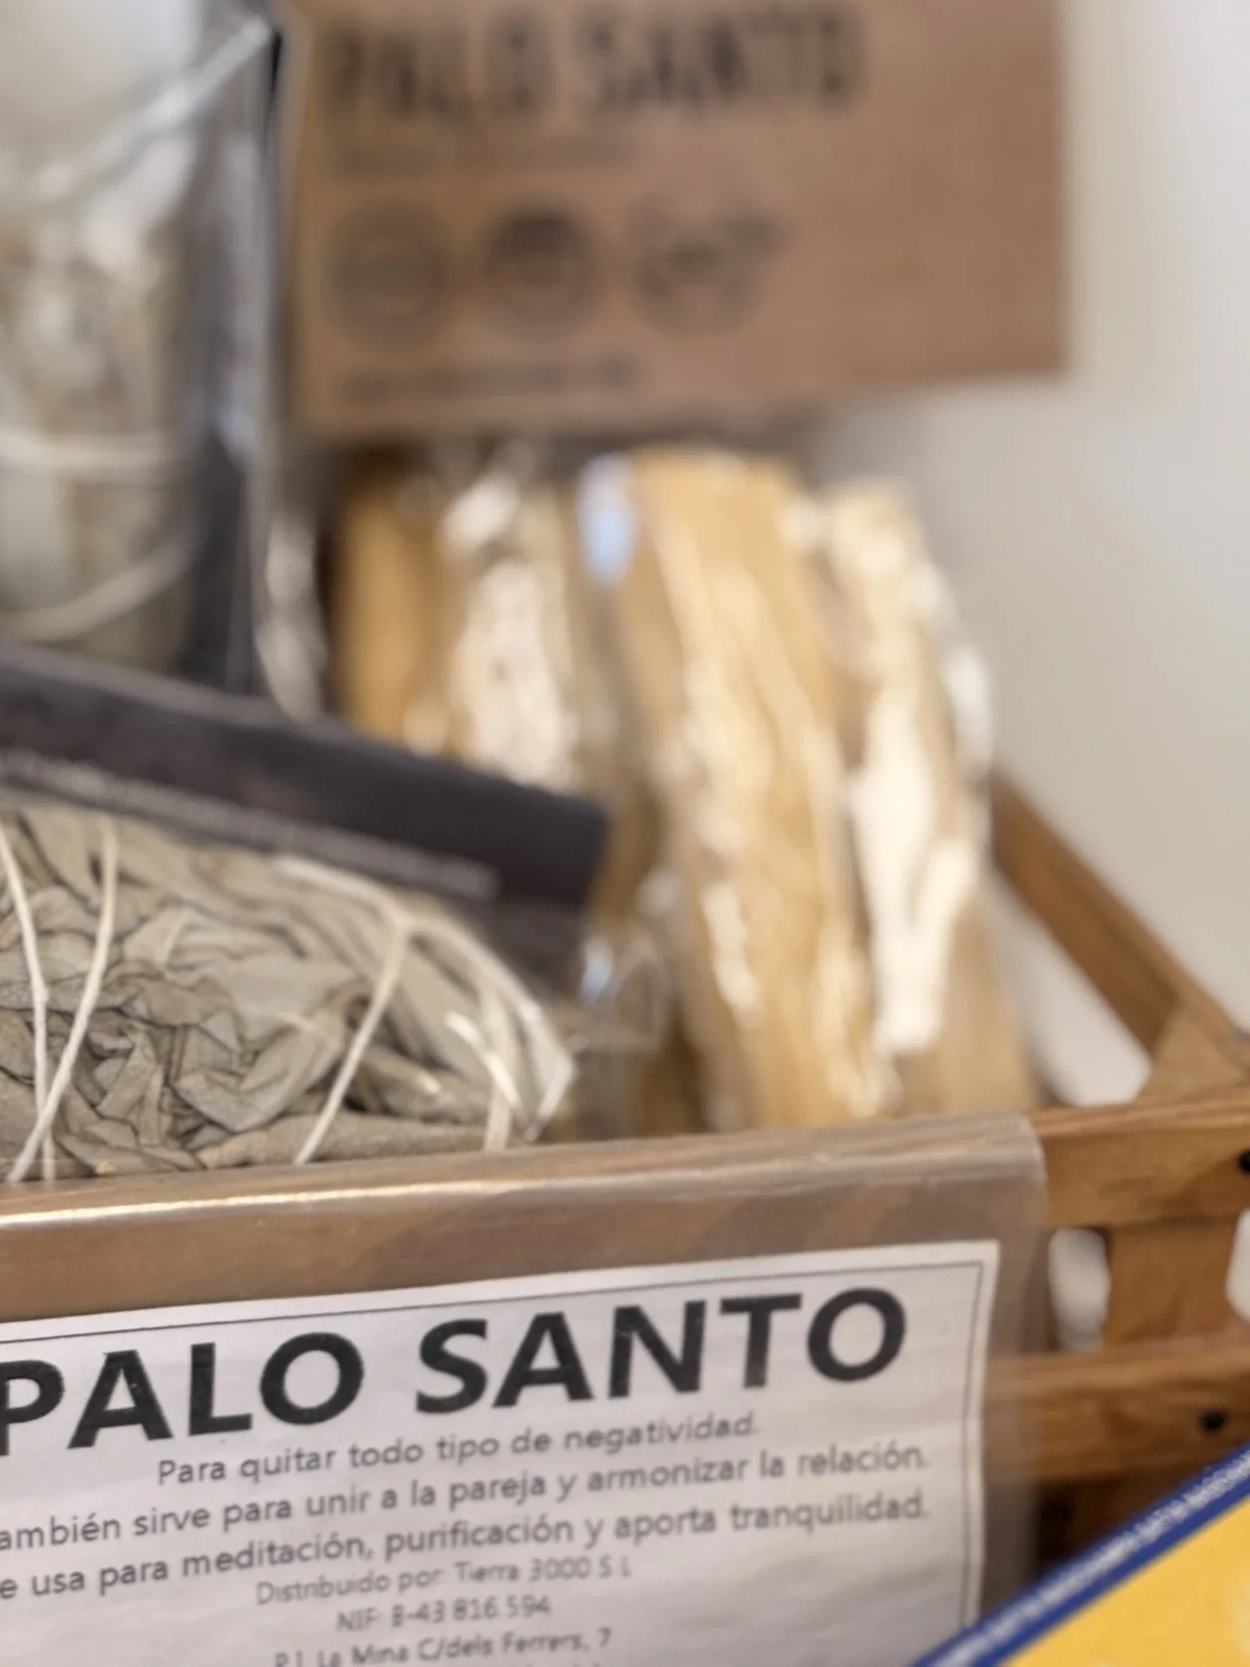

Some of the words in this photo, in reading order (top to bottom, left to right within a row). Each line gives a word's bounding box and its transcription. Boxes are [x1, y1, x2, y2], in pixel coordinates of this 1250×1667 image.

[415, 1288, 906, 1414] SANTO
[133, 1500, 210, 1536] sirve
[223, 1498, 292, 1532] para
[307, 1485, 370, 1515] unir
[380, 1487, 398, 1509] a
[411, 1480, 436, 1507] la
[449, 1472, 546, 1511] pareja
[557, 1473, 579, 1501] y
[587, 1456, 750, 1492] armonizar
[760, 1450, 786, 1478] la
[797, 1441, 930, 1477] relación.
[158, 1458, 227, 1485] Para
[240, 1447, 335, 1483] quitar
[350, 1441, 424, 1469] todo
[437, 1434, 500, 1464] tipo
[511, 1427, 551, 1454] de
[564, 1411, 760, 1455] negatividad.
[31, 1570, 86, 1596] usa
[98, 1560, 170, 1596] para
[182, 1535, 374, 1577] meditación,
[384, 1515, 574, 1562] purificación
[584, 1518, 606, 1548] y
[614, 1507, 717, 1546] aporta
[730, 1489, 930, 1534] tranquilidad.
[257, 1570, 391, 1606] Distribuido
[454, 1560, 520, 1583] Tierra
[530, 1556, 592, 1582] 3000
[598, 1627, 614, 1650] 7
